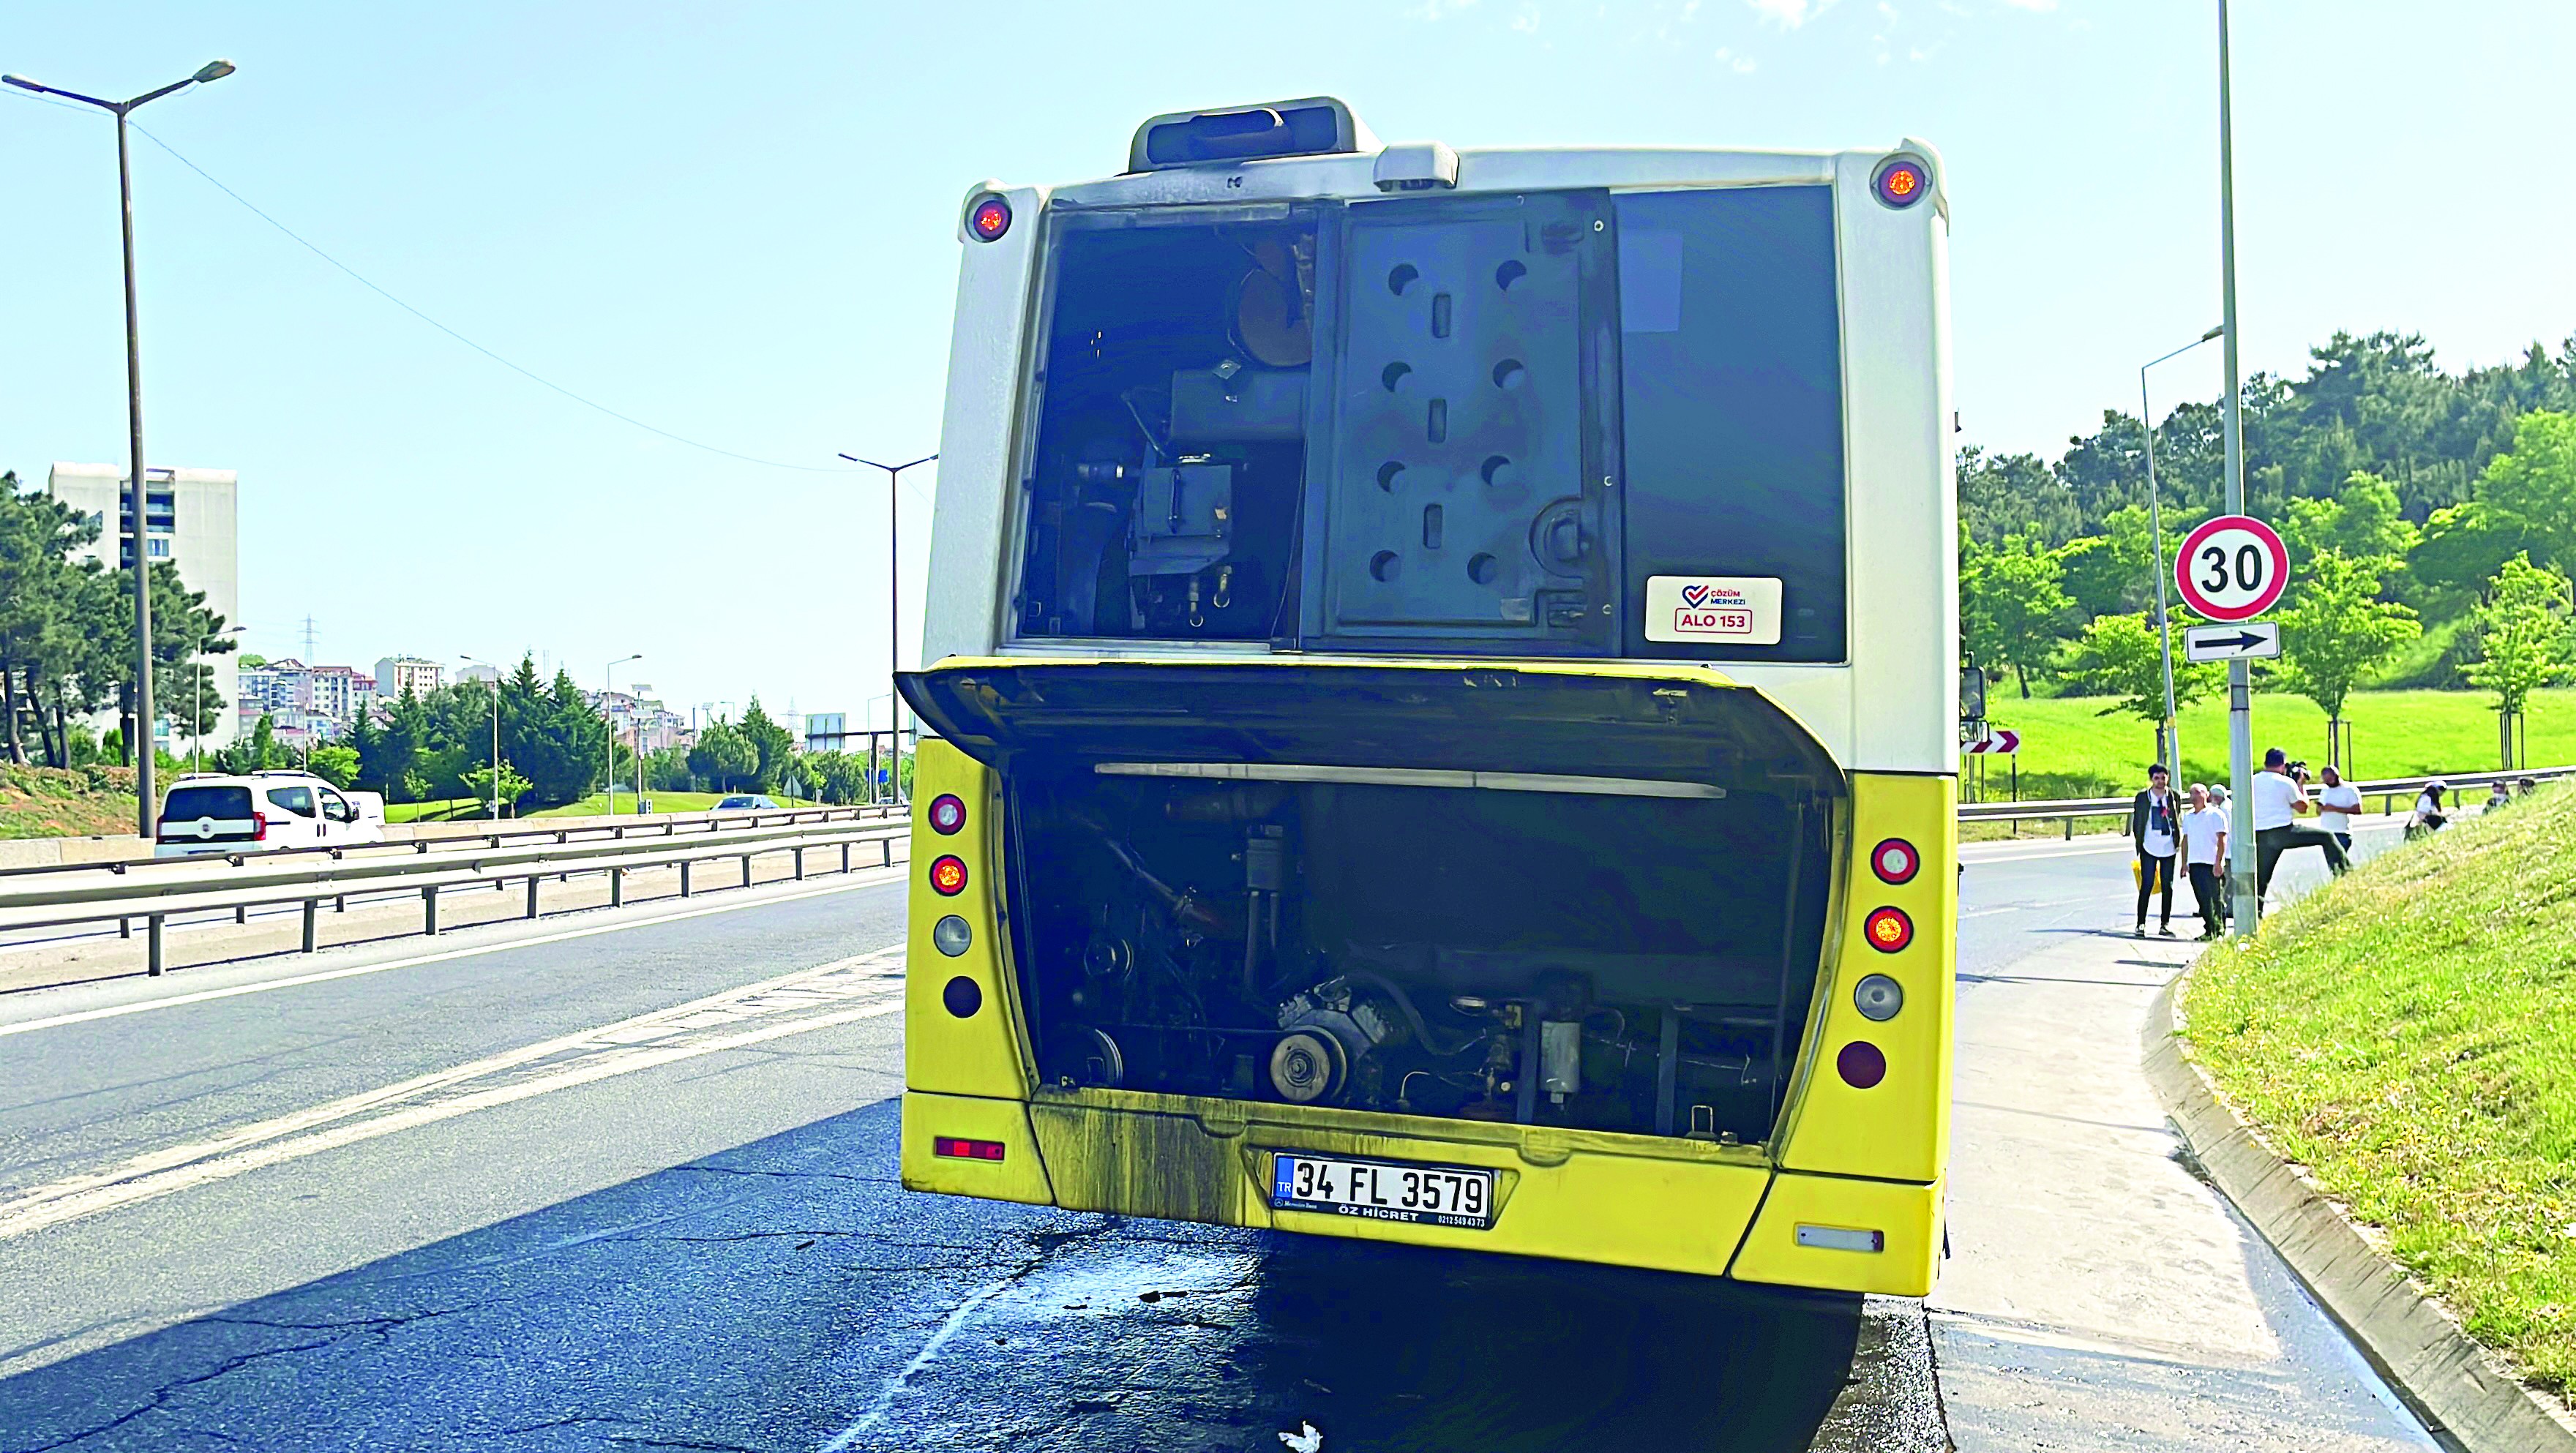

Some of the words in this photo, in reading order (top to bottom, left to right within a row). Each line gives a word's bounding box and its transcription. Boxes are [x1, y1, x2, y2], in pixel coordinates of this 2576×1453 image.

[2201, 544, 2262, 593] 30
[1711, 589, 1740, 597] ÇÖZÜM
[1682, 614, 1715, 627] ALO
[1720, 615, 1745, 628] 153
[1278, 1182, 1292, 1193] TR
[1296, 1163, 1333, 1199] 34
[1350, 1167, 1387, 1205] FL
[1401, 1172, 1483, 1214] 3579
[1338, 1204, 1358, 1215] ÖZ
[1363, 1207, 1419, 1221] HİCRET
[1438, 1215, 1453, 1225] 0212
[1467, 1217, 1475, 1226] 43
[1477, 1218, 1485, 1227] 73
